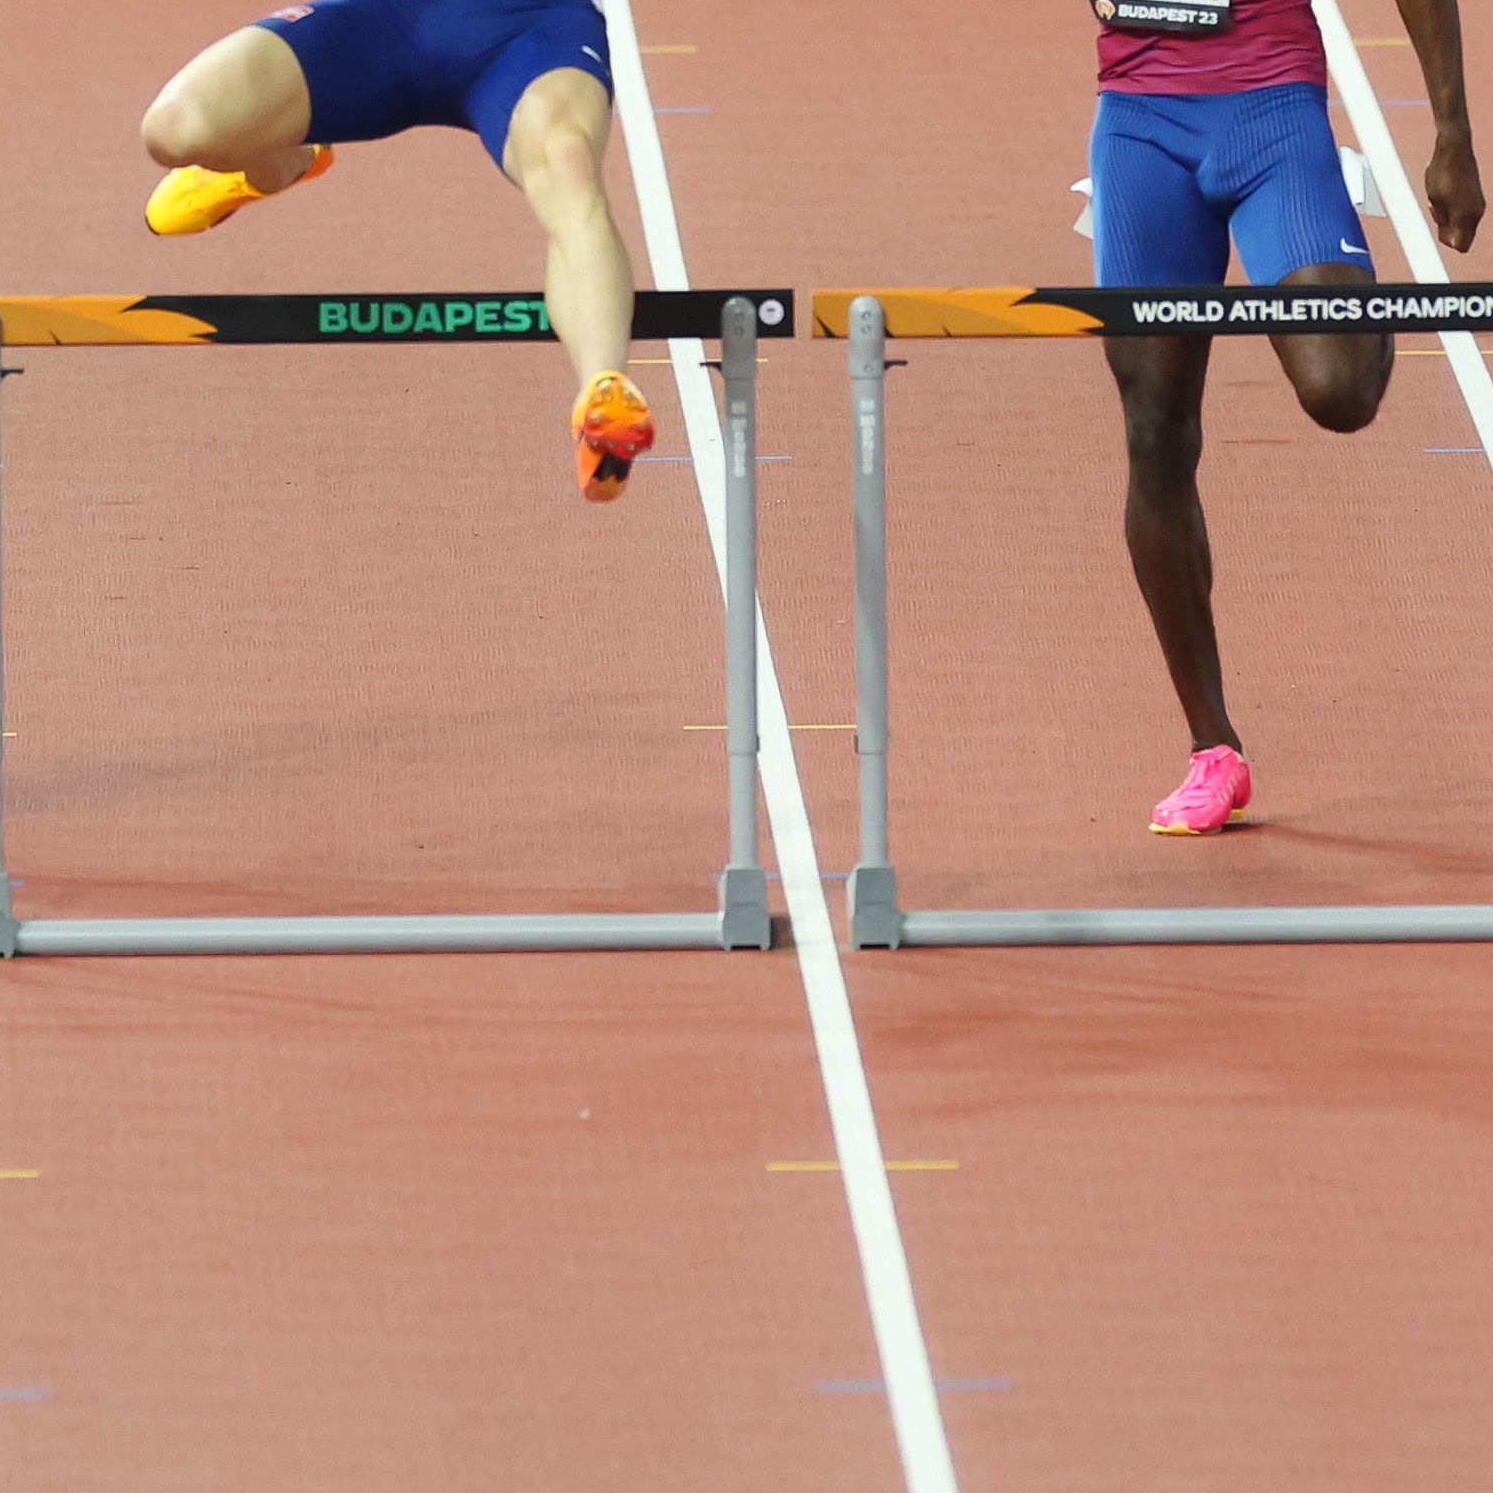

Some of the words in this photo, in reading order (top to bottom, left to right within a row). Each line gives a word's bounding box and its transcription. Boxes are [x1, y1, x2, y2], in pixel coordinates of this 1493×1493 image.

[1118, 4, 1198, 23] BUDAPEST
[1199, 11, 1218, 25] 23
[318, 301, 550, 333] BUDAPEST
[1133, 301, 1224, 323] WORLD
[1229, 299, 1363, 322] ATHLETICS
